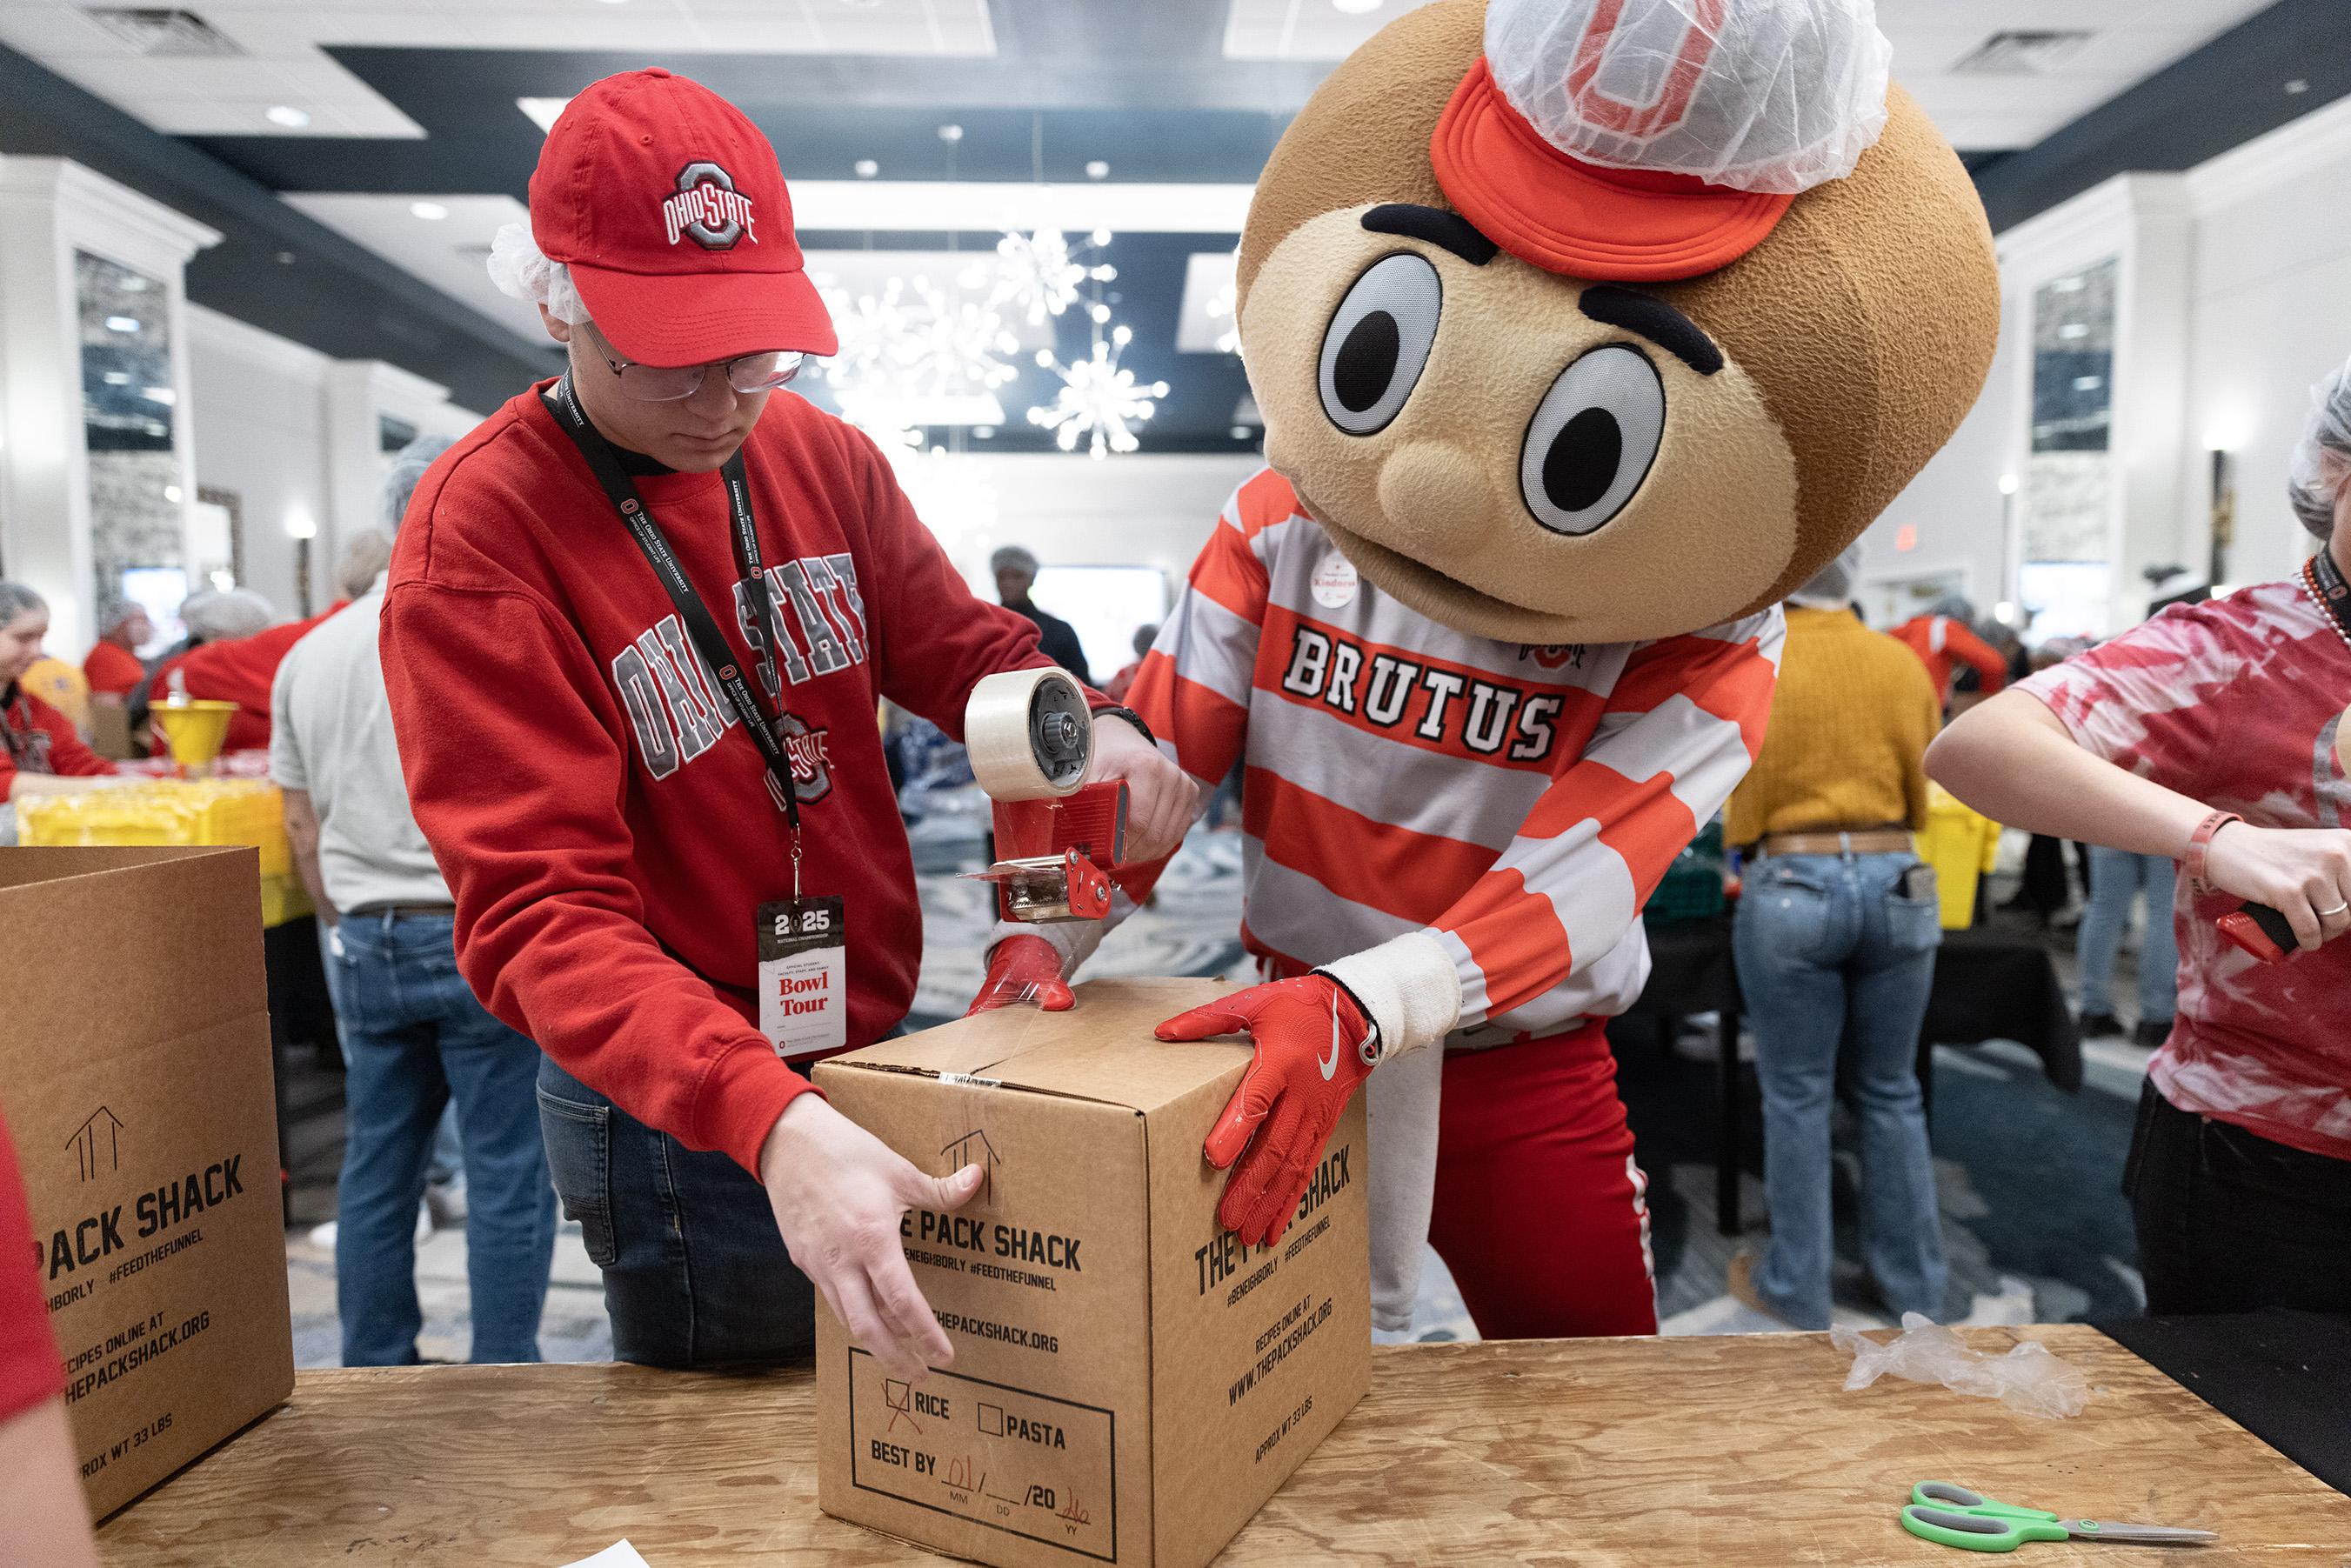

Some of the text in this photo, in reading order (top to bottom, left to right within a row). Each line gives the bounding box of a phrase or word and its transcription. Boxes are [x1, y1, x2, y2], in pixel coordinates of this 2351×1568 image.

[566, 390, 584, 425] UNIVERSITY
[732, 480, 743, 516] UNIVERSITY
[630, 517, 641, 531] OFFICE
[642, 537, 656, 557] STUDENT
[653, 555, 662, 564] LIFE
[638, 511, 689, 593] THE OHIO STATE UNIVERSITY
[727, 683, 736, 697] OFFICE
[738, 702, 751, 720] STUDENT
[1282, 624, 1564, 763] BRUTUS
[735, 677, 744, 691] THE
[741, 690, 751, 706] OHIO
[750, 704, 762, 724] STATE
[760, 722, 779, 755] UNIVERSITY
[779, 971, 828, 996] Bowl
[779, 998, 828, 1017] Tour
[137, 1154, 244, 1238] SHACK
[109, 1228, 204, 1284] #FEEDTHEFUNNEL
[920, 1210, 985, 1252] PACK
[994, 1224, 1081, 1271] SHACK
[1227, 1256, 1279, 1308] #BENEIGHBORLY
[1284, 1215, 1331, 1264] #FEEDTHEFUNNEL
[970, 1263, 1057, 1291] #FEEDTHEFUNNEL
[1195, 1231, 1235, 1296] THE
[106, 1321, 145, 1354] ONLINE
[149, 1311, 164, 1331] AT
[932, 1311, 1059, 1353] HEPACKSHACK.ORG
[1255, 1294, 1311, 1355] RECIPES ONLINE AT
[1228, 1298, 1332, 1407] WWW.THEPACKSHACK.ORG
[915, 1391, 950, 1419] RICE
[111, 1438, 130, 1461] WT
[133, 1428, 149, 1448] 33
[151, 1412, 173, 1437] LBS
[1007, 1415, 1065, 1450] PASTA
[1255, 1395, 1312, 1465] APPROX WT 33 LBS
[872, 1439, 910, 1468] BEST
[916, 1452, 936, 1476] BY
[950, 1491, 968, 1505] MM
[996, 1505, 1010, 1517] DD
[1065, 1524, 1077, 1536] YY
